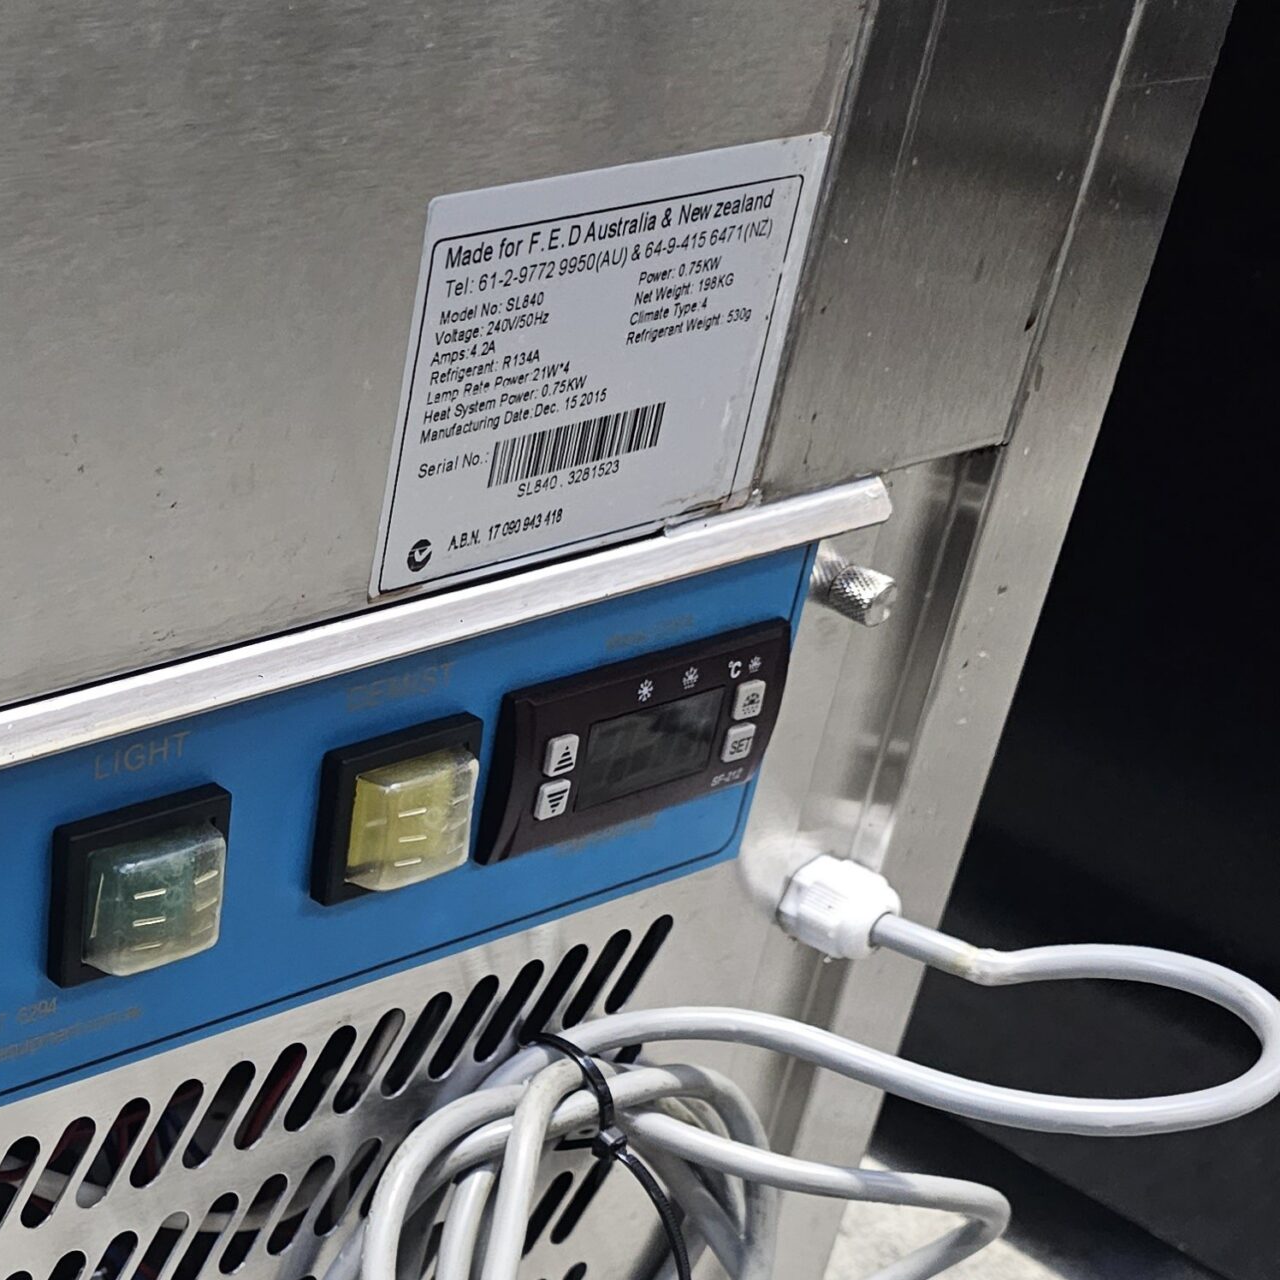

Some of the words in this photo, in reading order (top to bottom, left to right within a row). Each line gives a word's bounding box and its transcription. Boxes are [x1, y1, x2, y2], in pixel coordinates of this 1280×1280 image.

[445, 242, 493, 269] Made
[498, 238, 523, 260] for
[584, 211, 657, 244] Australia
[661, 207, 672, 228] &
[678, 203, 713, 226] New
[713, 188, 775, 219] zealand
[445, 277, 474, 298] Tel:
[478, 261, 555, 291] 61-2-9772
[631, 244, 641, 261] &
[645, 231, 706, 259] 64-9-415
[709, 218, 773, 246] 6471(NZ)
[638, 268, 675, 286] Power:
[678, 256, 722, 277] 0.75KW
[634, 291, 652, 306] Net
[656, 283, 694, 301] Weight:
[698, 273, 734, 292] 198KG
[439, 306, 477, 326] Model
[480, 302, 502, 318] No:
[506, 291, 545, 313] SL840
[626, 320, 683, 346] Refrigerant
[686, 313, 724, 333] Weight:
[727, 308, 752, 324] 530g
[629, 306, 669, 326] Climate
[435, 326, 484, 346] Voltage:
[486, 310, 550, 337] 240V/50Hz
[429, 360, 498, 386] Refrigerant:
[502, 349, 540, 371] R134A
[423, 407, 450, 425] Heat
[454, 398, 496, 419] System
[499, 388, 538, 407] Power:
[541, 375, 588, 398] 0.75KW
[427, 388, 459, 406] Lamp
[463, 381, 490, 398] Rate
[420, 415, 501, 445] Manufacturing
[564, 396, 577, 411] 15
[579, 387, 607, 408] 2015
[418, 455, 458, 478] Serial
[517, 475, 558, 498] SL840
[567, 459, 620, 485] 3281523
[448, 529, 481, 552] A.B.N.
[488, 524, 501, 541] 17
[523, 513, 543, 531] 943
[544, 508, 563, 527] 418
[94, 731, 190, 781] LIGHT
[729, 736, 753, 755] SET
